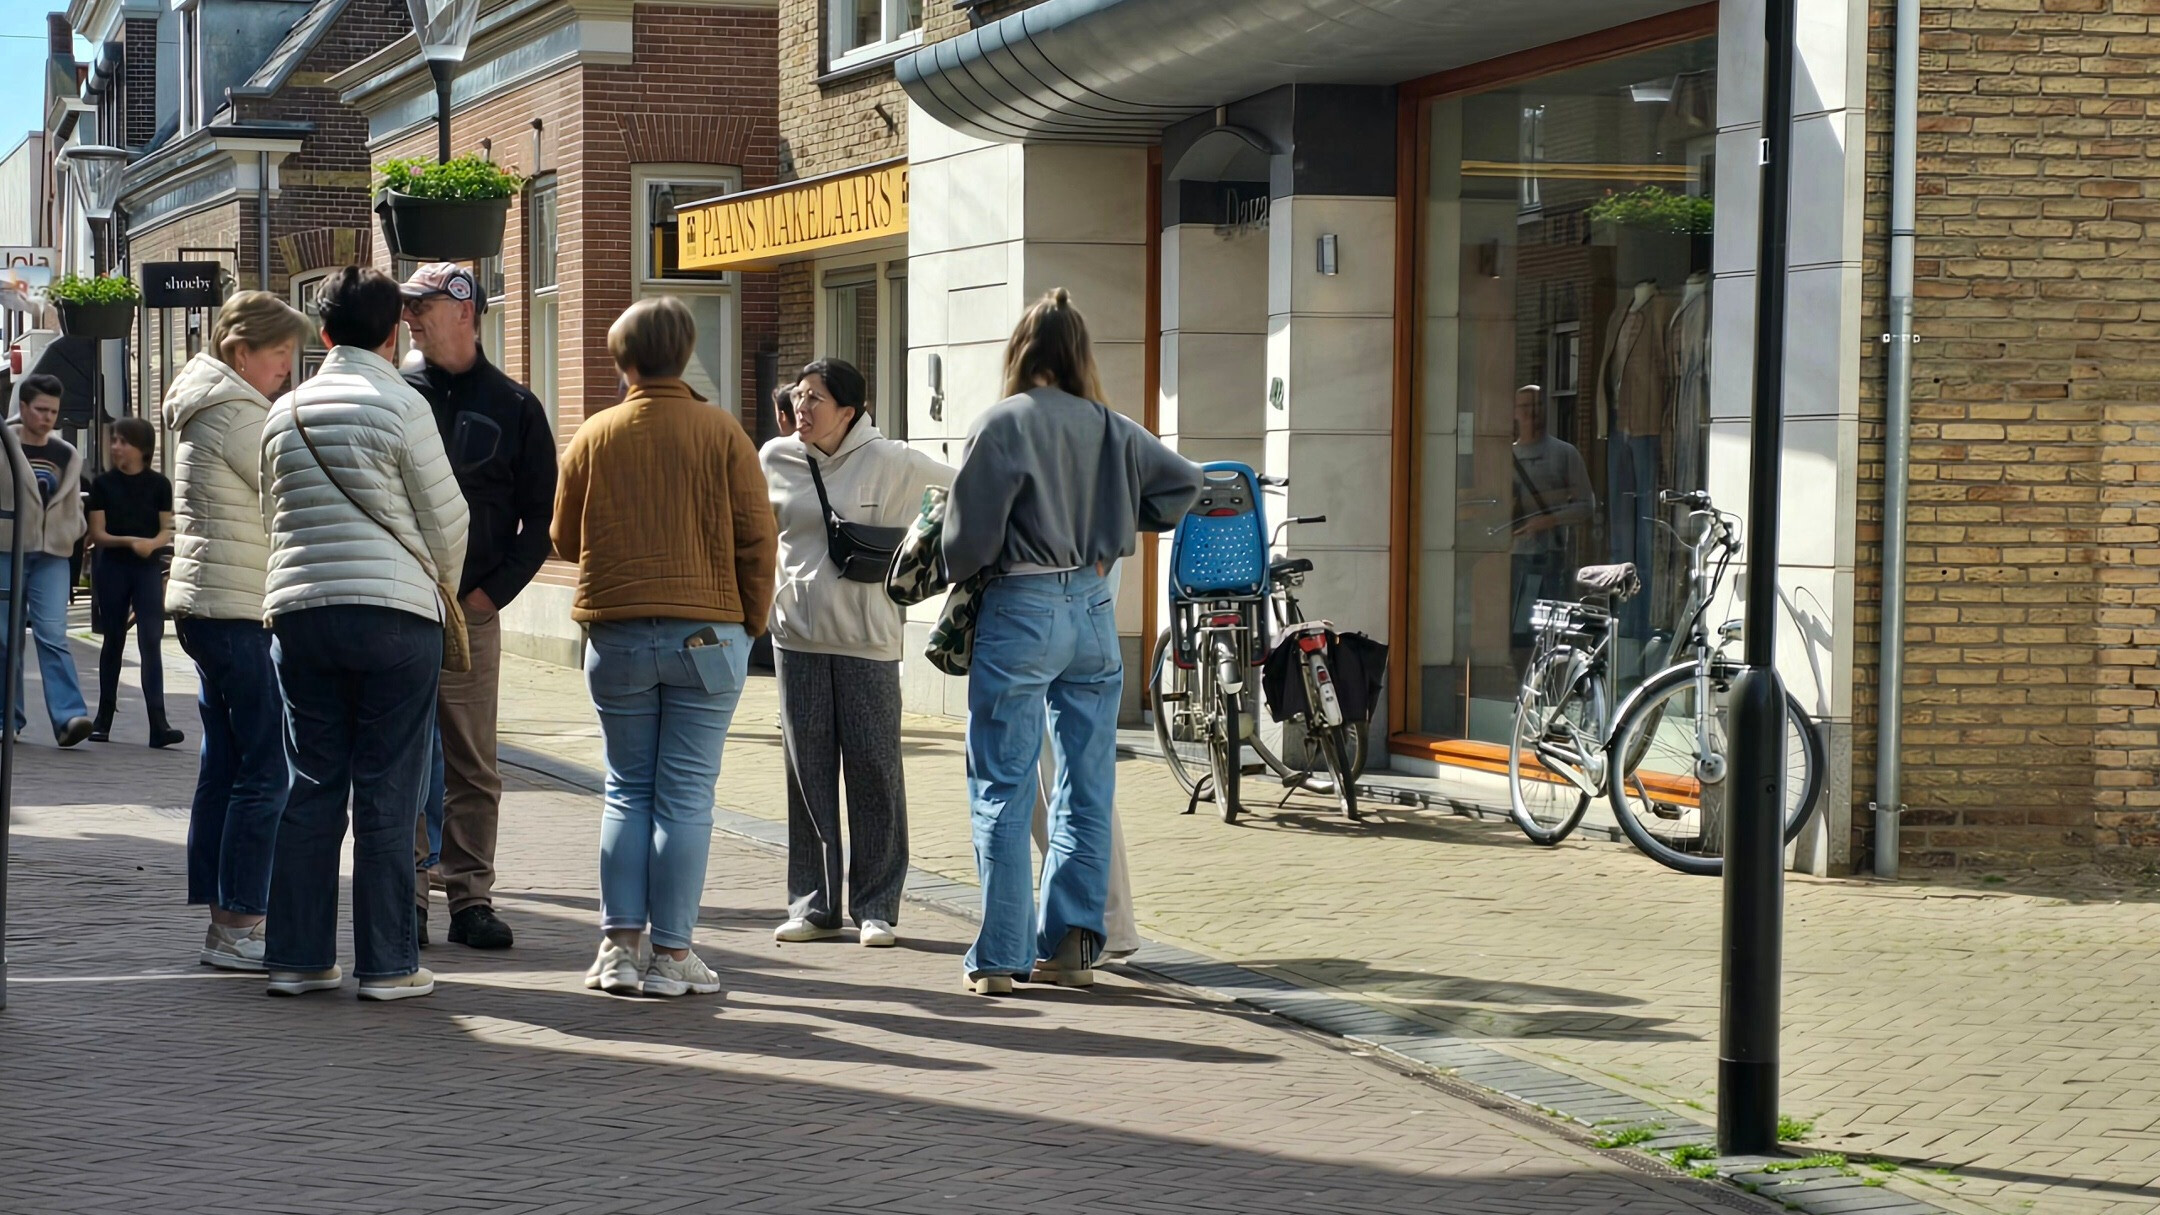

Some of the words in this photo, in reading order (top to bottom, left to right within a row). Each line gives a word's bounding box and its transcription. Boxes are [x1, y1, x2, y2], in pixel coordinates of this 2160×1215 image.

[702, 201, 757, 258] PAANS
[762, 171, 892, 249] MAKELAARS
[165, 275, 211, 292] shoeby
